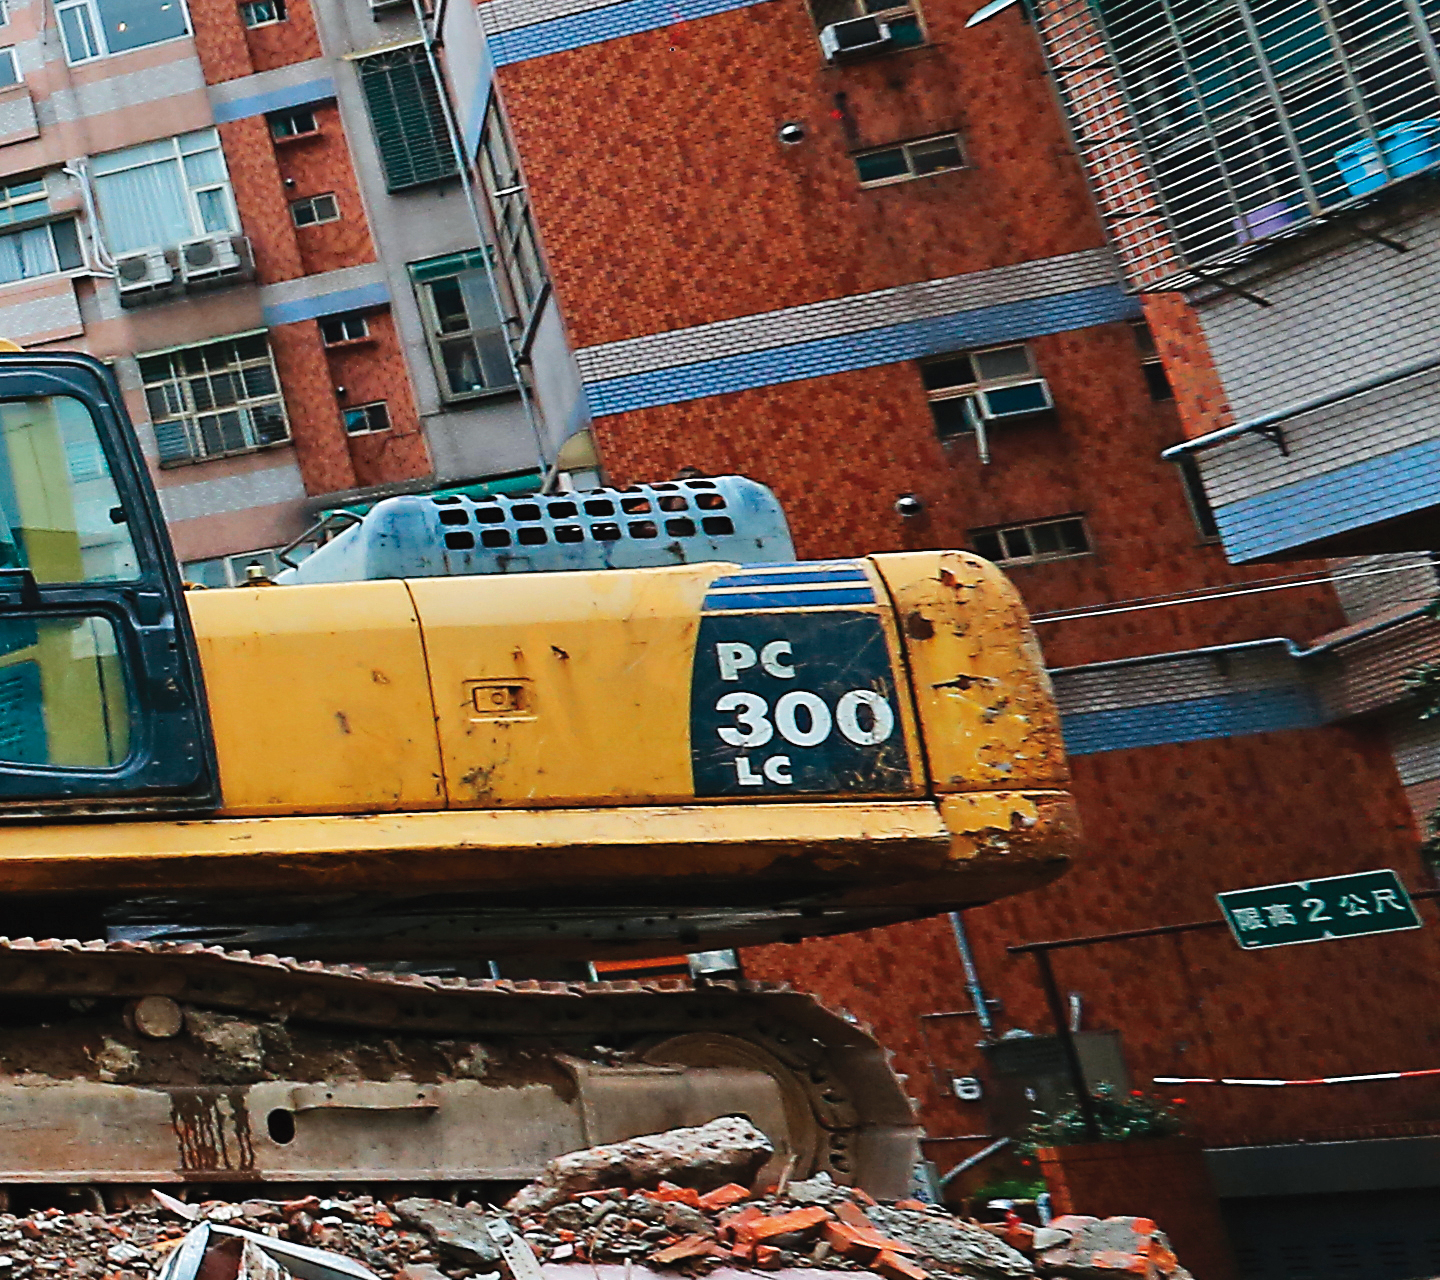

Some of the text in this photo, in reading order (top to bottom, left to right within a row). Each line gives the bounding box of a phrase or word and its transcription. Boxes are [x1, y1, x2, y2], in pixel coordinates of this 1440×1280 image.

[716, 640, 796, 681] PC
[715, 689, 895, 748] 300
[734, 755, 794, 786] LC
